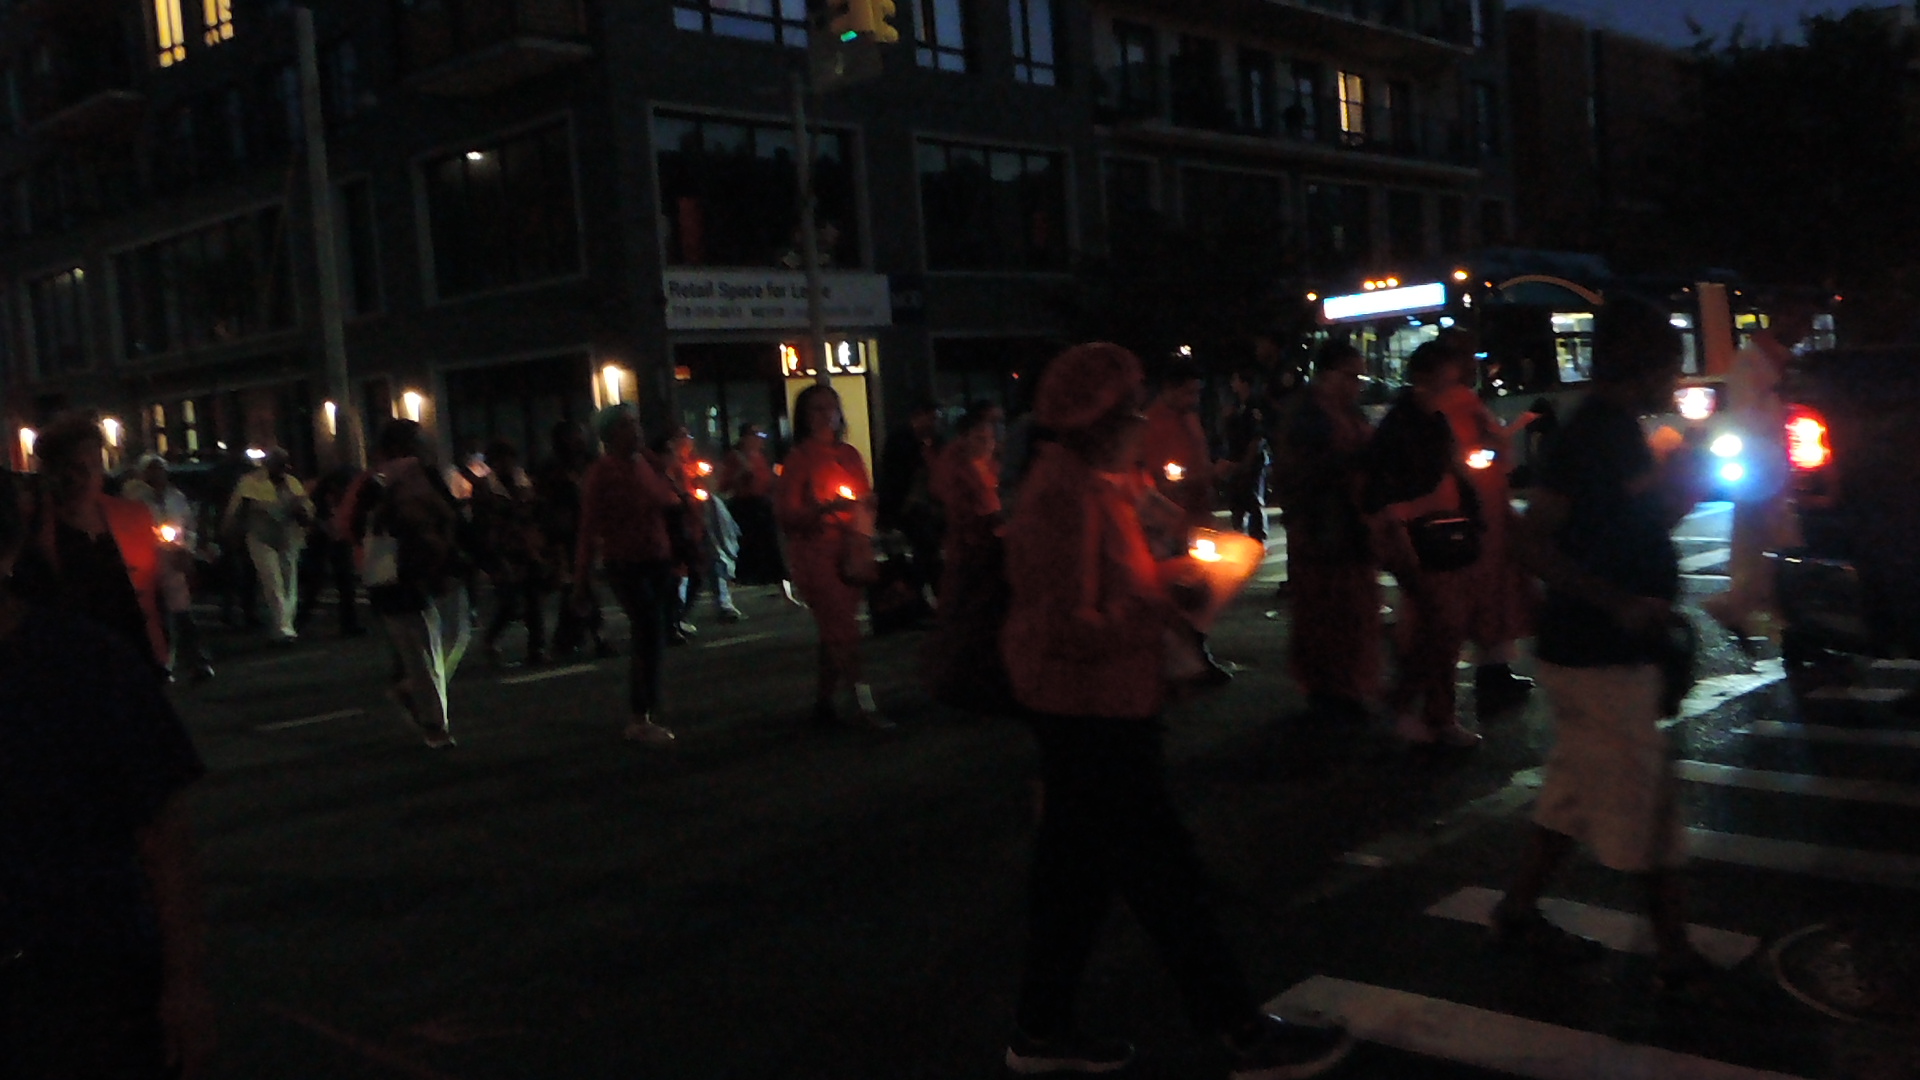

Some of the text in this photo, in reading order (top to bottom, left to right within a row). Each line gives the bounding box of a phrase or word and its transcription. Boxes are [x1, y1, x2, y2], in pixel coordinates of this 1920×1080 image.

[669, 280, 831, 300] Retail Space for Lee
